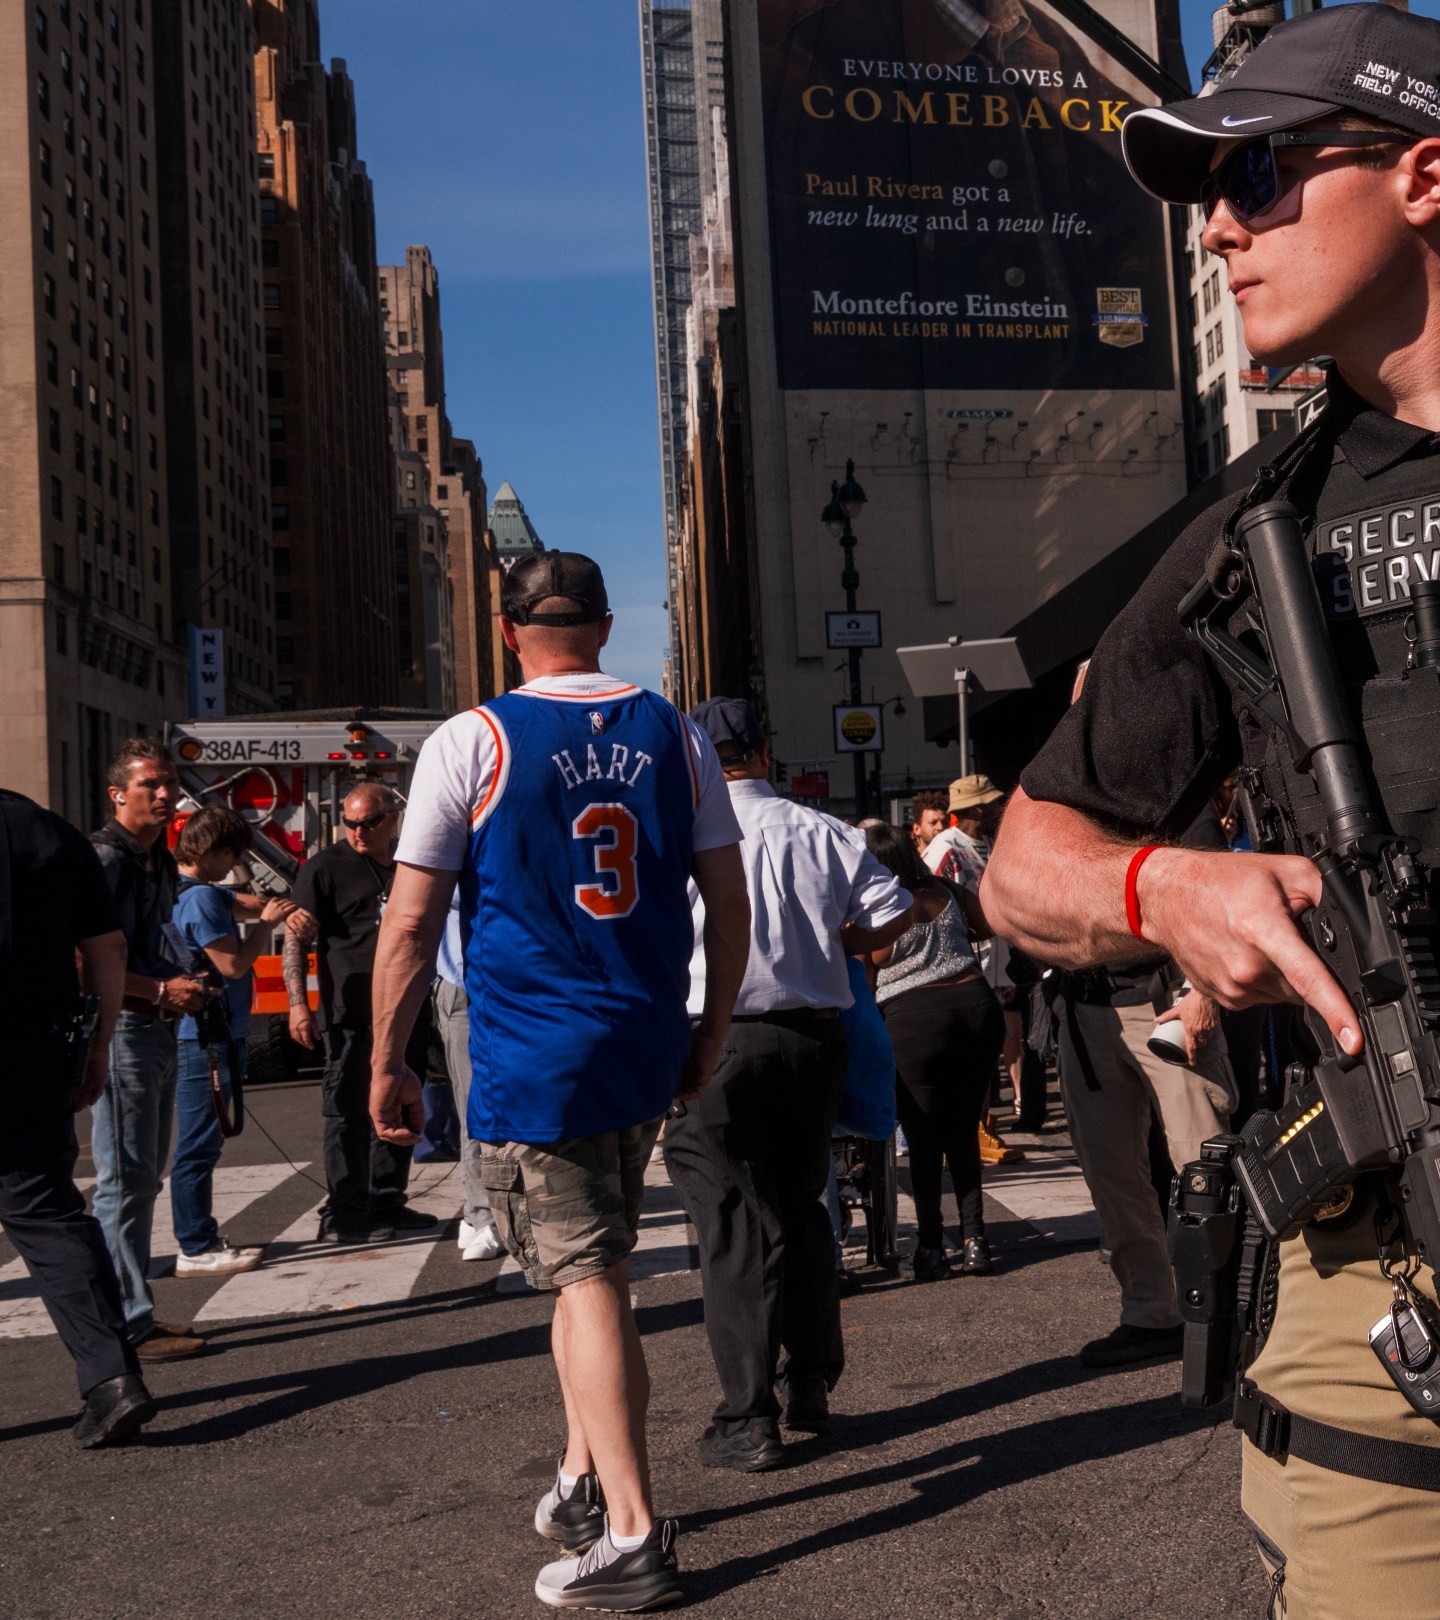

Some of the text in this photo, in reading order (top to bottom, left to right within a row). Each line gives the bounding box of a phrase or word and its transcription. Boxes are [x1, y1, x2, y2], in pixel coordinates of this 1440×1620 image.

[843, 59, 1088, 88] EVERYONE LOVES A
[1354, 74, 1393, 95] FIELD
[1365, 61, 1400, 82] NEW
[802, 85, 1128, 133] COMEBACK
[805, 174, 1010, 206] Paul Rivera got a
[807, 206, 1092, 239] new lung and a new life.
[812, 291, 1068, 318] Montefiore Einstein
[1100, 290, 1138, 304] BEST
[812, 321, 1069, 340] NATIONAL LEADER IN TRANSPLANT
[201, 634, 218, 683] NEW
[845, 729, 872, 737] TUNNEL
[206, 740, 301, 761] 38AF-413
[551, 743, 653, 790] HART
[572, 802, 641, 920] 3
